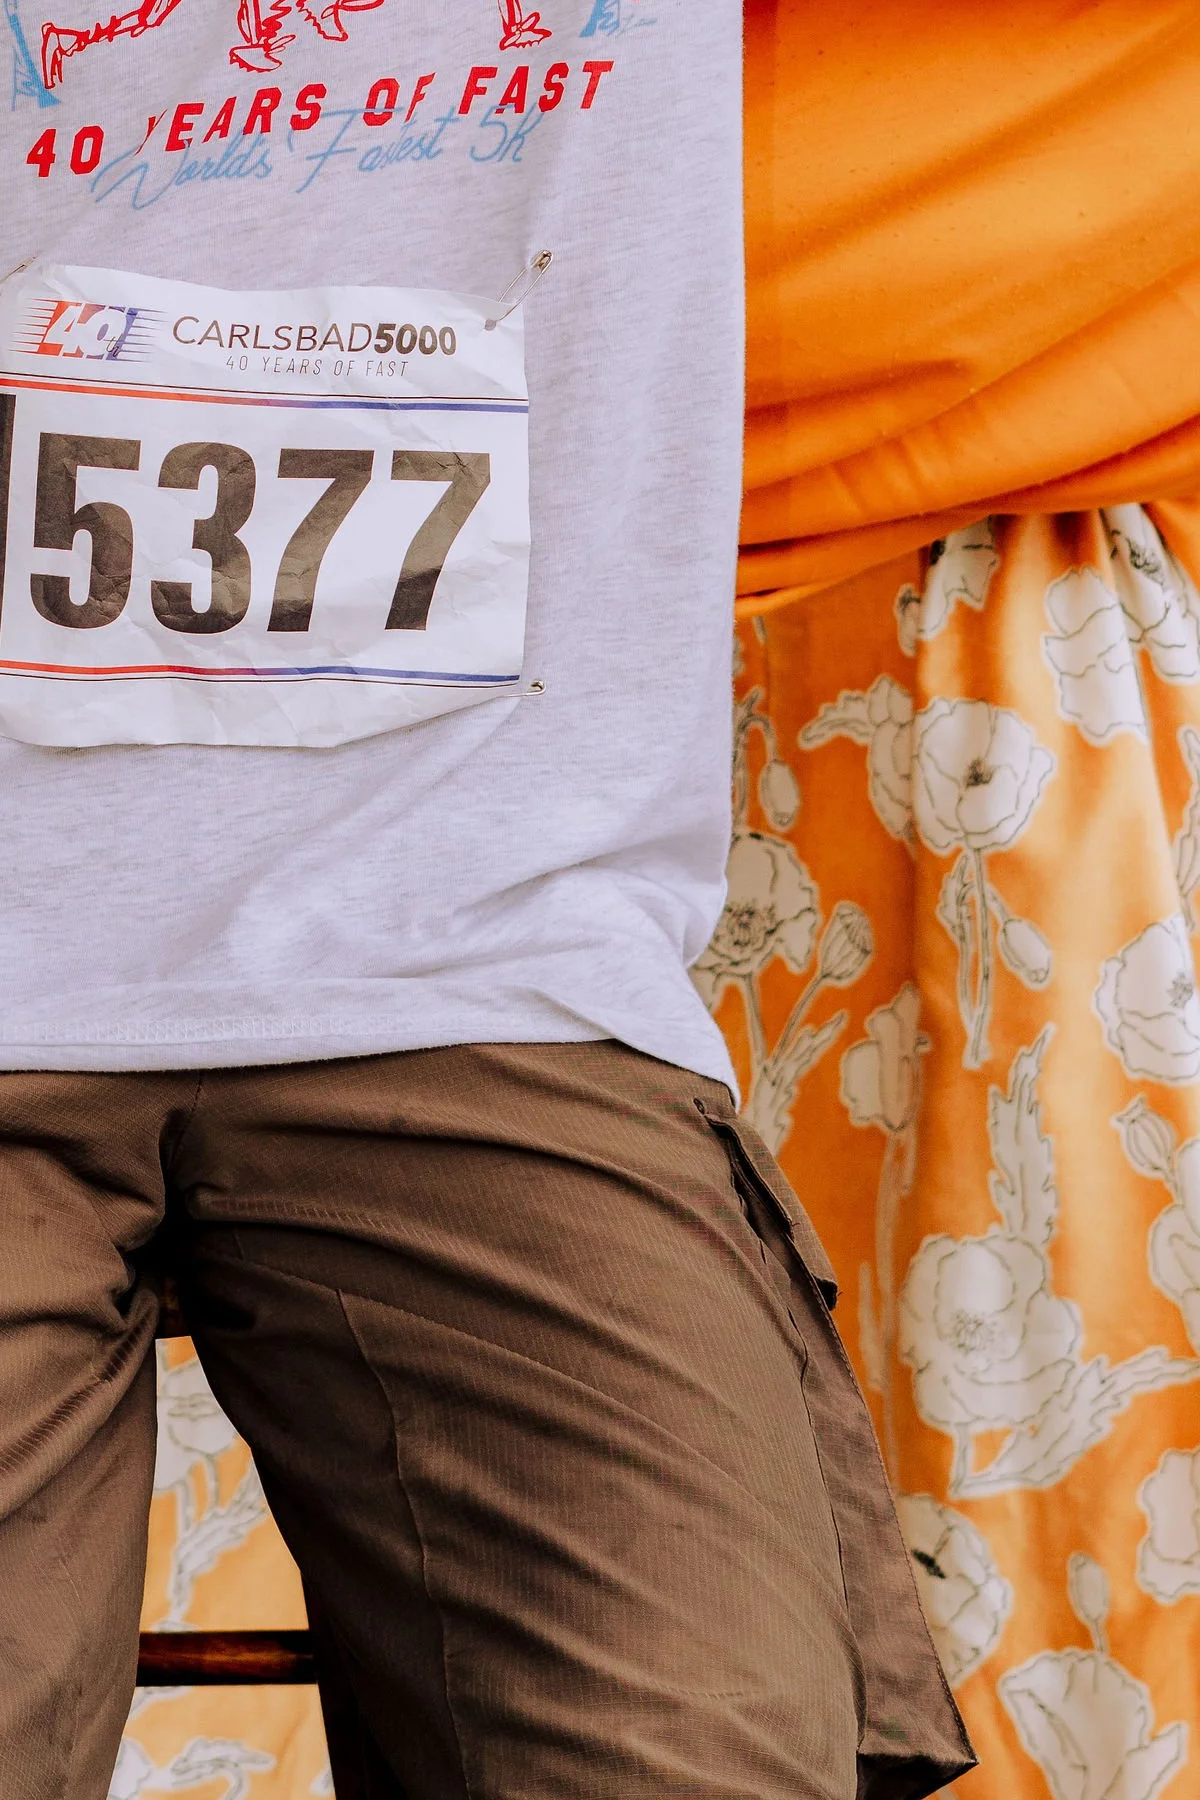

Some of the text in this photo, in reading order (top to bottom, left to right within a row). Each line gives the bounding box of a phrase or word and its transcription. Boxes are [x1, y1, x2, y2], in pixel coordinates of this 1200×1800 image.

[26, 125, 105, 178] 40
[364, 71, 437, 126] OF
[459, 60, 615, 115] FAST
[469, 101, 541, 163] 5K
[172, 315, 458, 356] CARLSBAD5000
[226, 356, 409, 377] 40 YEARS OF FAST
[29, 432, 491, 635] 5377
